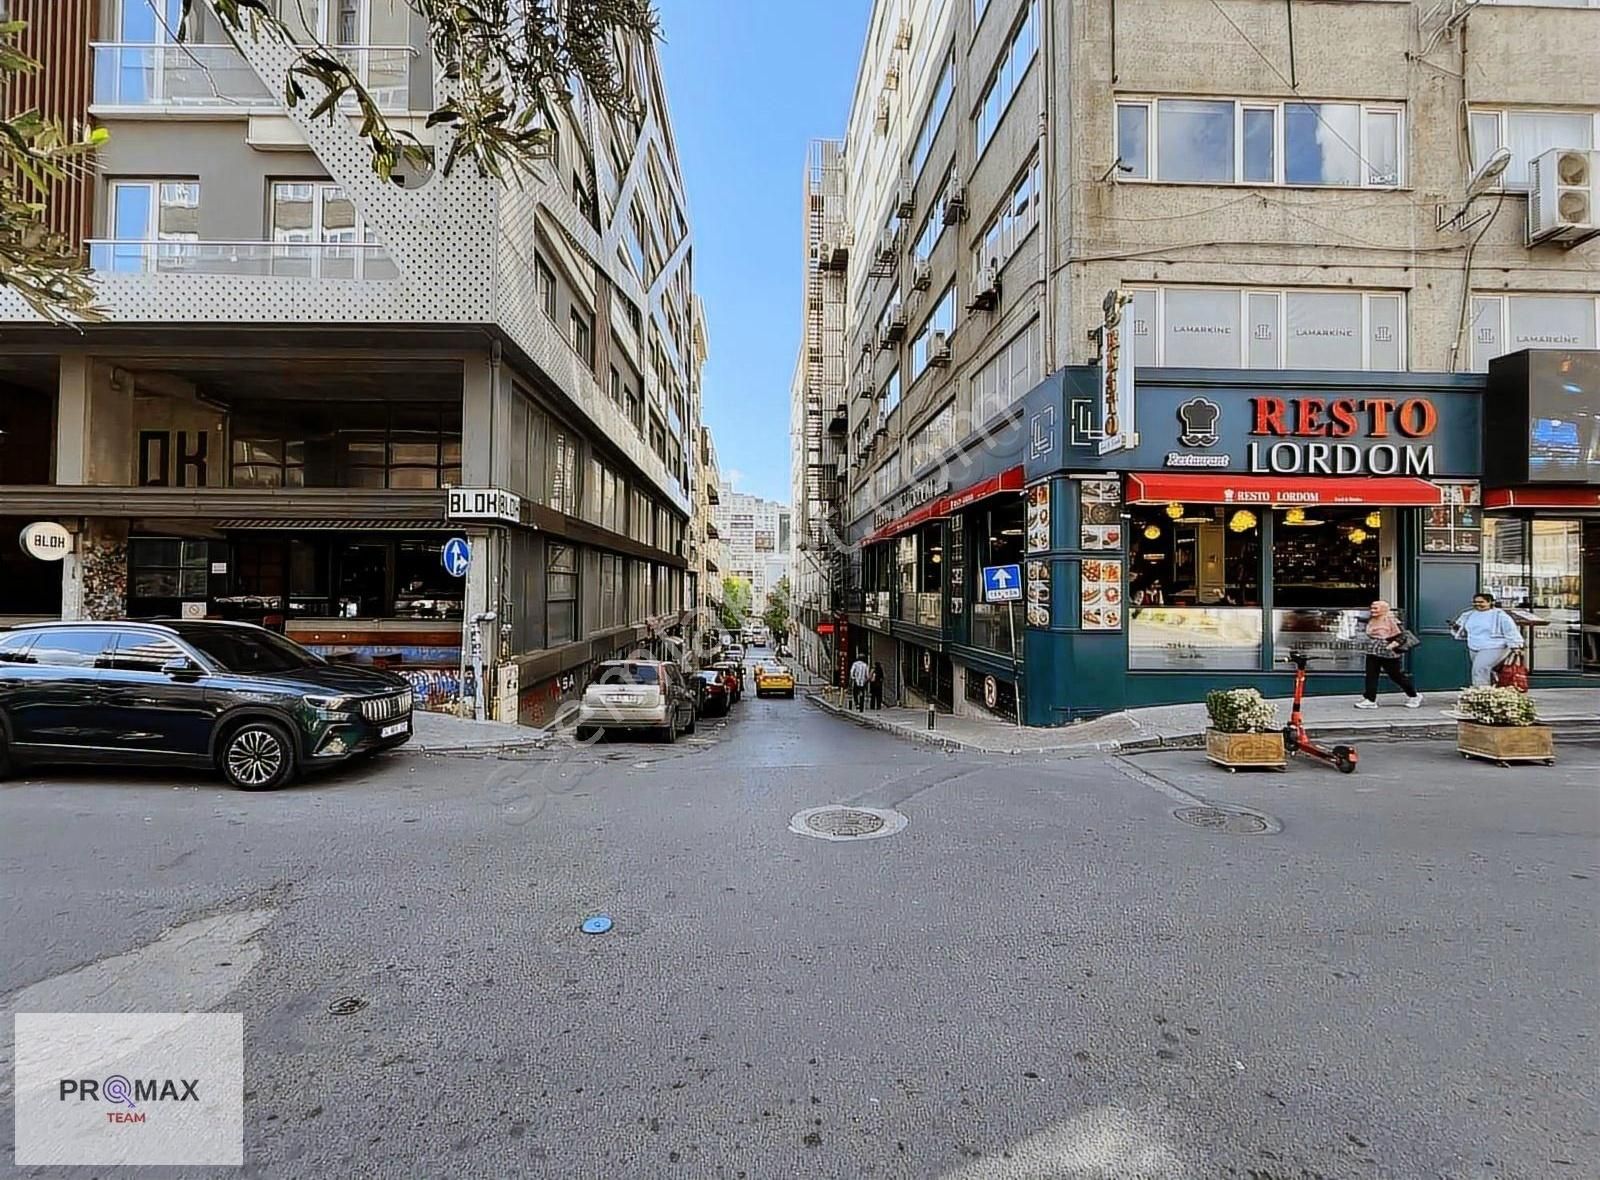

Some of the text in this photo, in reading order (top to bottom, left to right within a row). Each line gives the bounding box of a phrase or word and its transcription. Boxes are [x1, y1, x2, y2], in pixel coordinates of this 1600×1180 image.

[1250, 395, 1438, 438] RESTO
[1166, 452, 1231, 467] Restaurant
[1251, 441, 1435, 476] LORDOM
[1237, 490, 1319, 502] RESTO LORDOM
